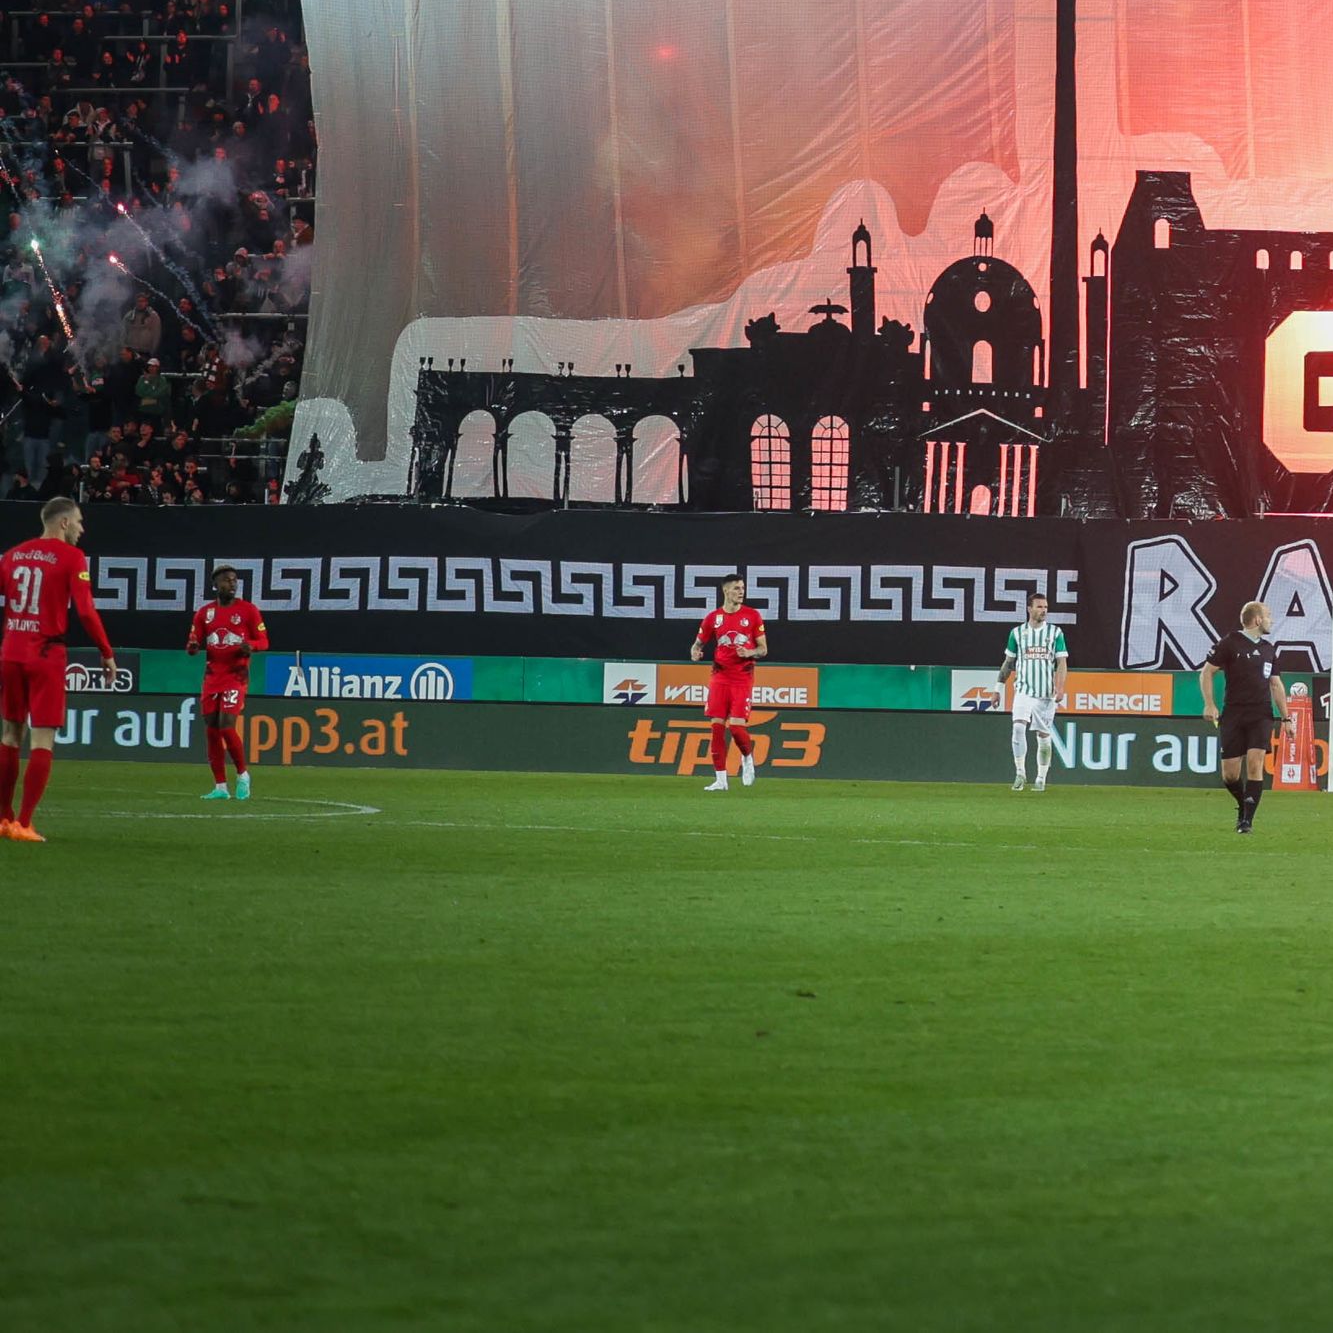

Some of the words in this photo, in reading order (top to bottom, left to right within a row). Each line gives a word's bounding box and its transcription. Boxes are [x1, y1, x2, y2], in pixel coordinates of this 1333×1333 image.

[10, 565, 43, 615] 31
[284, 665, 402, 699] Allianz
[664, 685, 710, 702] WIE
[751, 686, 807, 704] ERGIE
[1075, 693, 1162, 712] ENERGIE
[114, 698, 196, 749] auf
[1050, 722, 1136, 771] Nur
[1152, 733, 1218, 774] au
